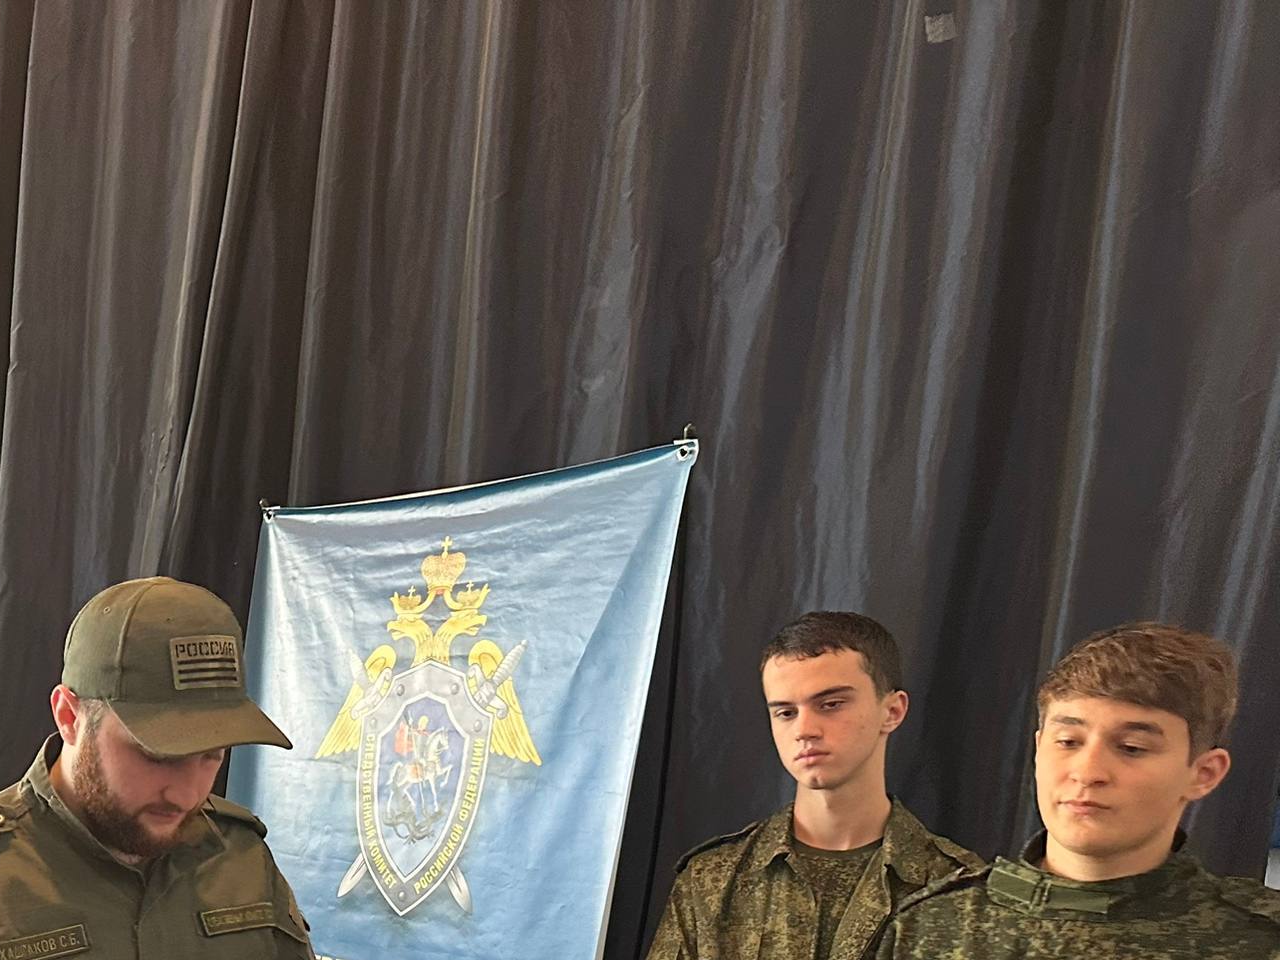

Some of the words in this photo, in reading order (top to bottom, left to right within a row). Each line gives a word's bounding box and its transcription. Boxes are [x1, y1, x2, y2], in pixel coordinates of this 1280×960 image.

[175, 641, 235, 658] РОССИЯ
[413, 825, 464, 894] РОССИЙСКОЙ
[459, 737, 485, 822] ФЕДЕРАЦИИ
